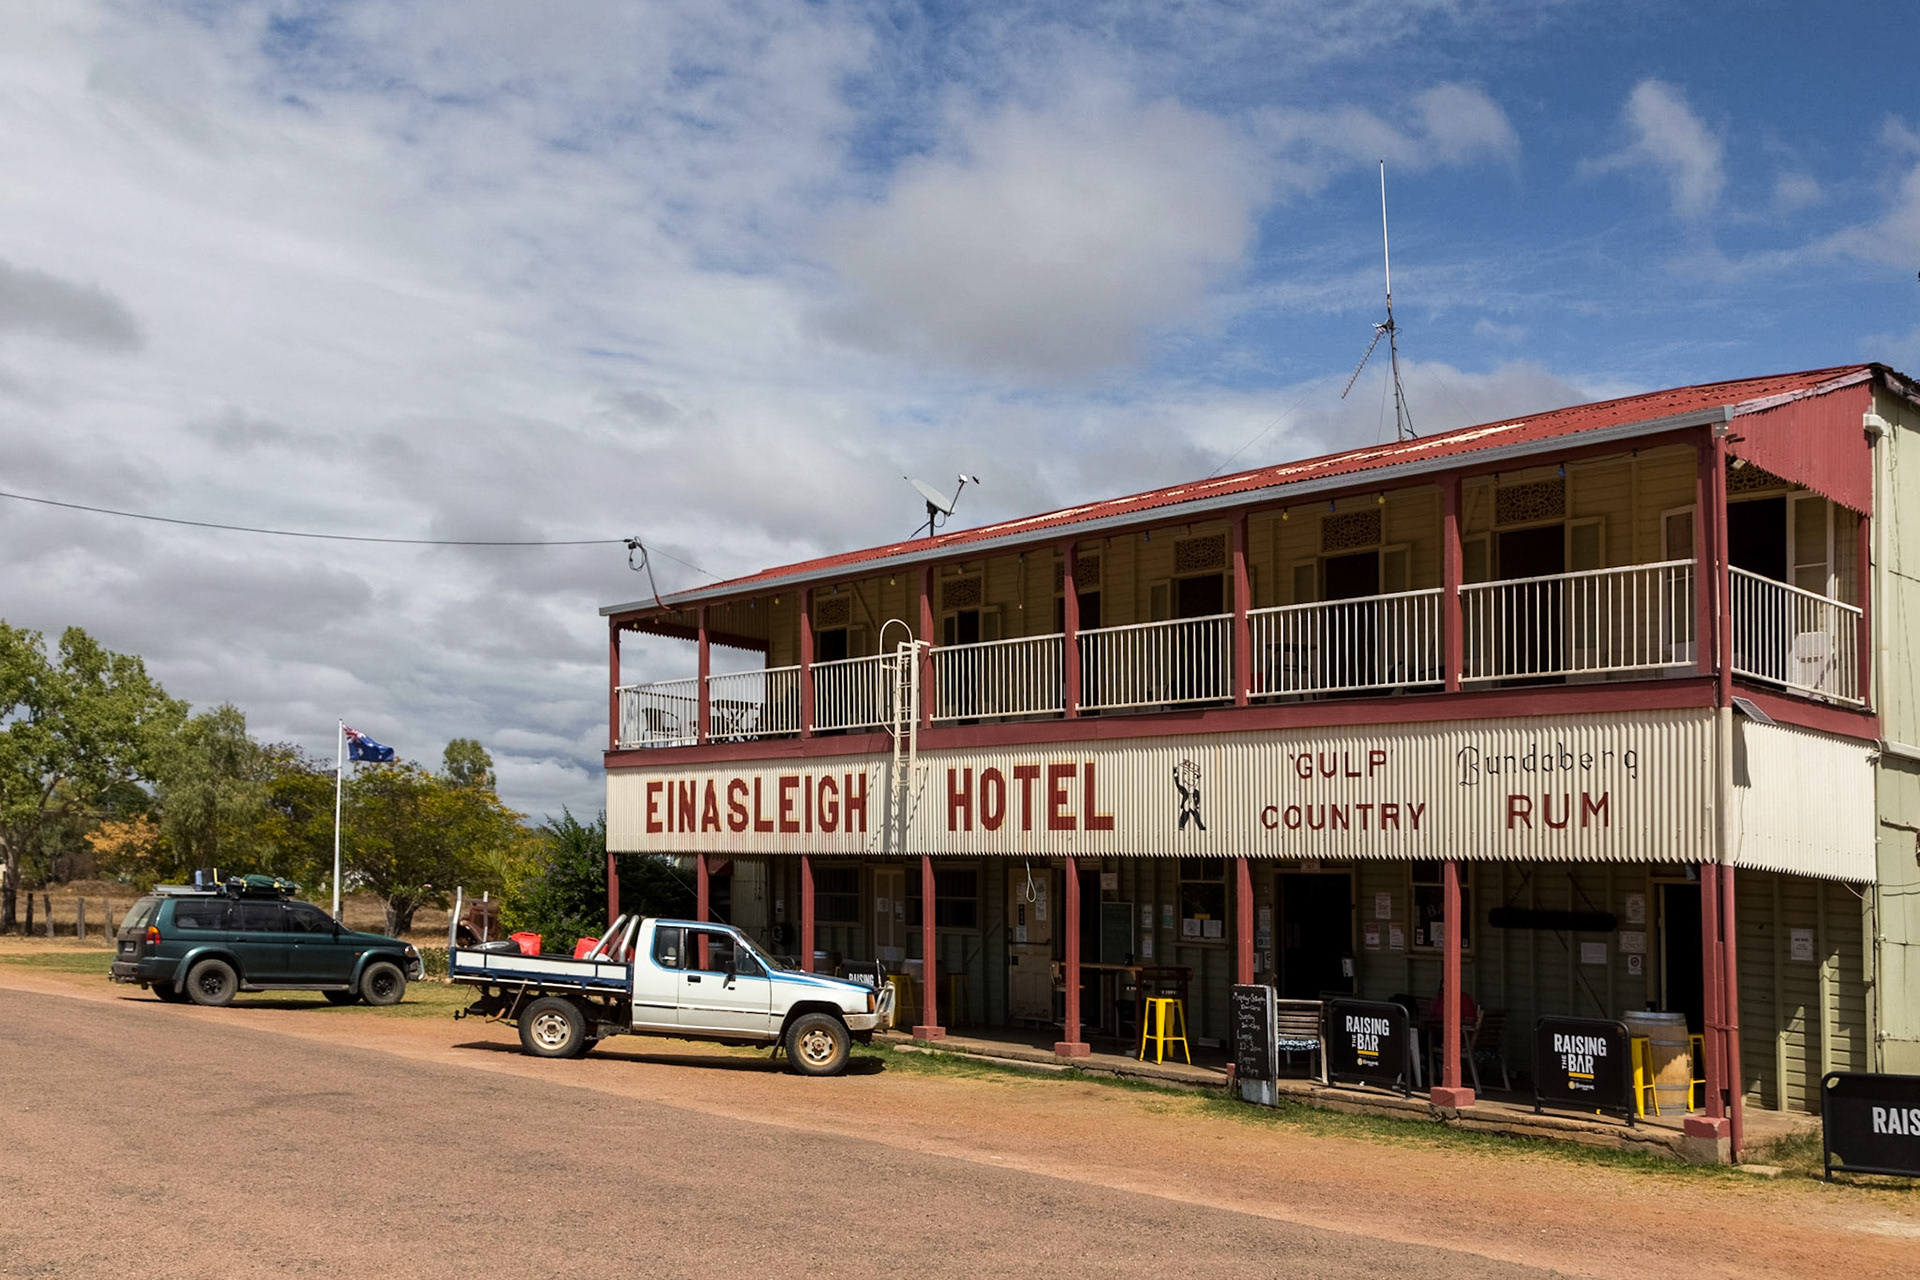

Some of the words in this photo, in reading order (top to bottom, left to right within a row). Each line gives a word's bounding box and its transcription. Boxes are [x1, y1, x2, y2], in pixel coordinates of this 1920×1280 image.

[1457, 743, 1638, 786] Bundaberg
[646, 771, 867, 834] EINASLEIGH
[947, 762, 1114, 832] HOTEL
[1507, 792, 1610, 829] RUM
[1261, 803, 1425, 831] COUNTRY
[849, 973, 875, 986] RAISING
[1346, 1015, 1390, 1037] RAISING
[1357, 1033, 1379, 1052] BAR
[1553, 1033, 1607, 1057] RAISING
[1568, 1053, 1595, 1074] BAR
[1871, 1106, 1920, 1136] RAIS
